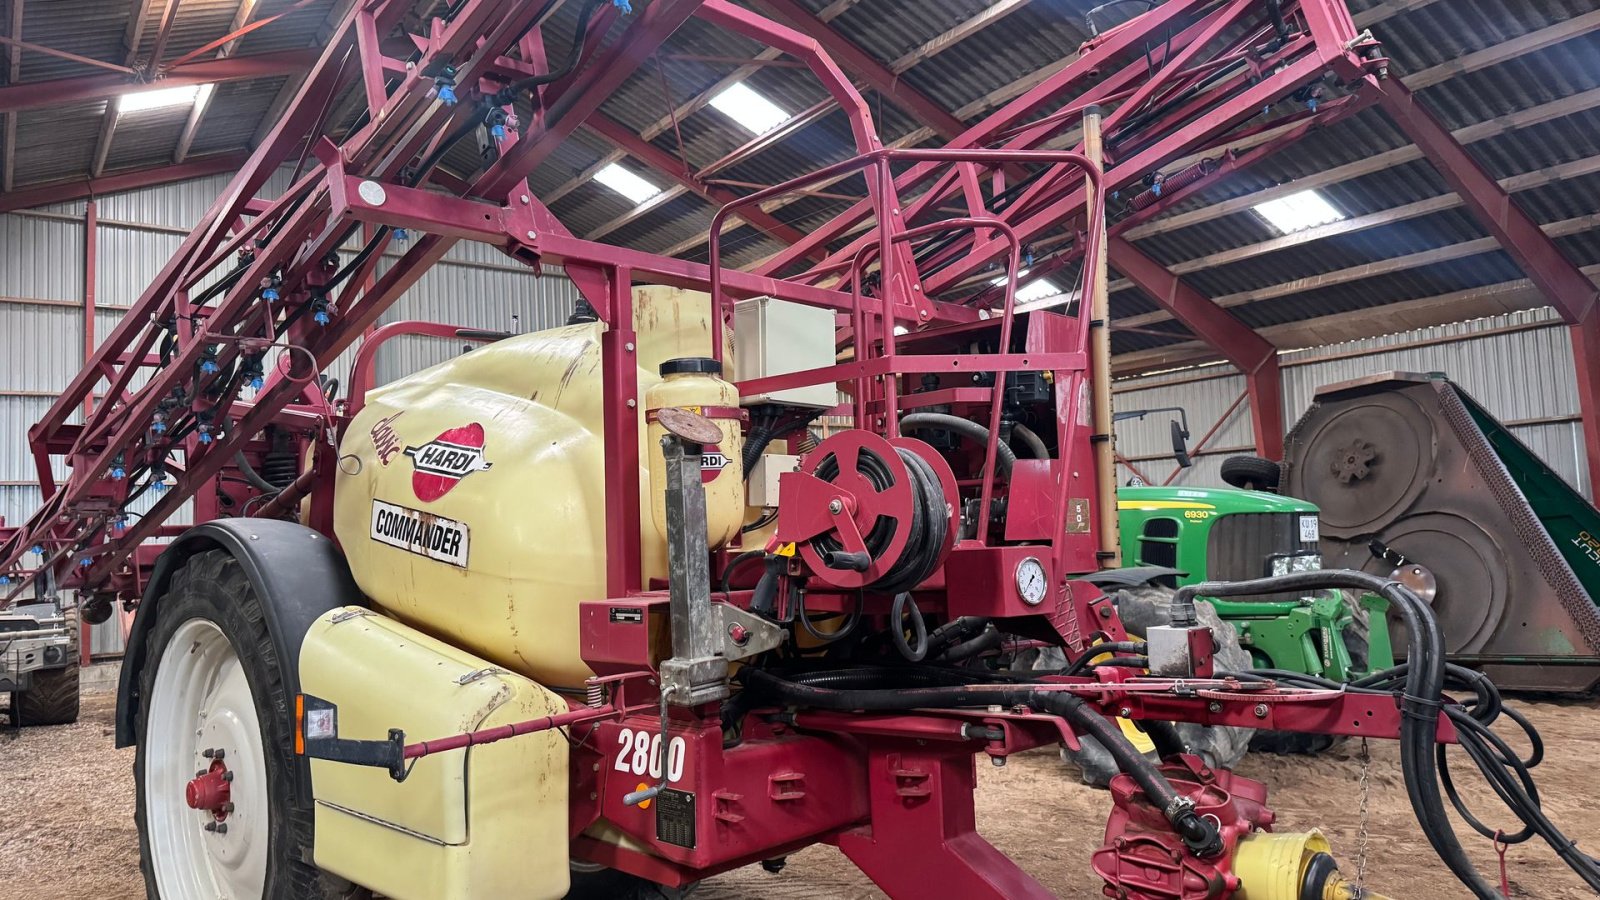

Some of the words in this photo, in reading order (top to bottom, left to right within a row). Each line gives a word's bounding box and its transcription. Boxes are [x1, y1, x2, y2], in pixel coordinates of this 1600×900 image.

[419, 446, 477, 472] HARDI
[701, 456, 722, 466] RDI
[1184, 510, 1209, 519] 6930
[376, 508, 462, 557] COMMANDER
[614, 728, 685, 782] 2800
